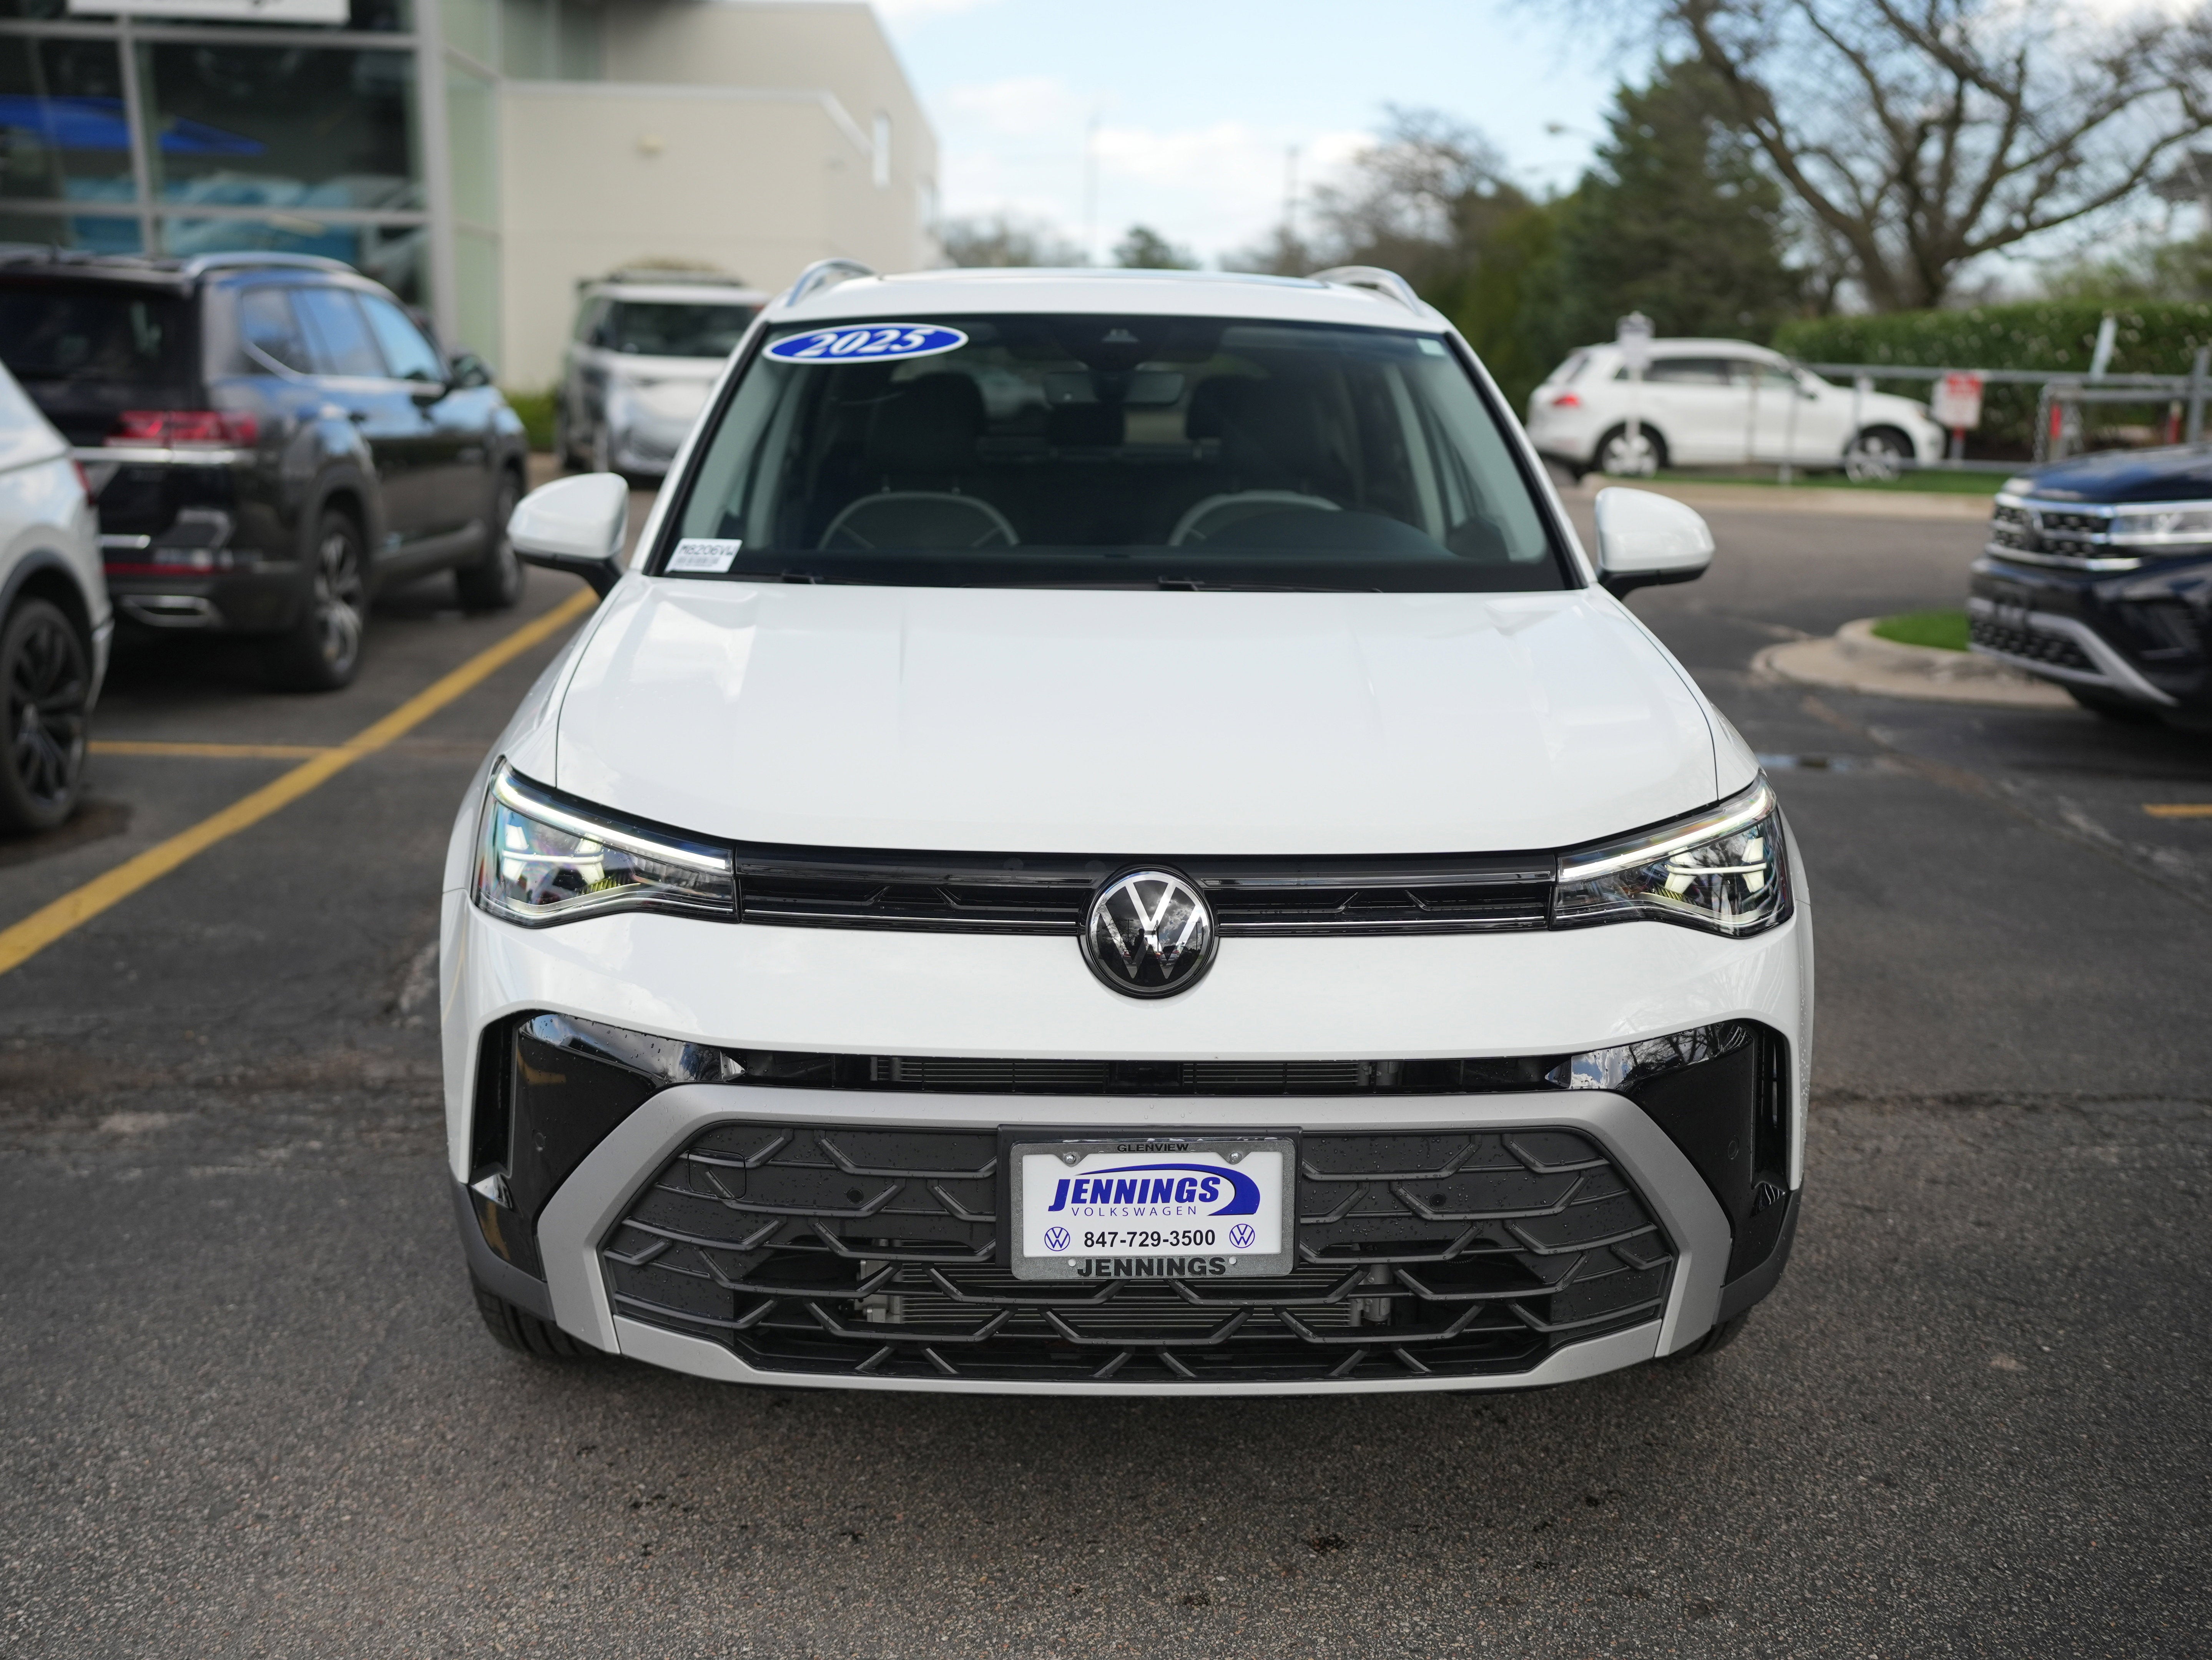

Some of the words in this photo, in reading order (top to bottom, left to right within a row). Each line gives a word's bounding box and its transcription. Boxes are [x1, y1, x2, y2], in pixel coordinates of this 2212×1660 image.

[792, 328, 937, 357] 2025
[1117, 1143, 1190, 1153] GLENVIEW
[1047, 1177, 1221, 1212] JENNINGS
[1071, 1206, 1197, 1217] VOLKSWAGEN
[1084, 1229, 1216, 1248] 847-729-3500
[1077, 1257, 1226, 1277] JENNINGS
